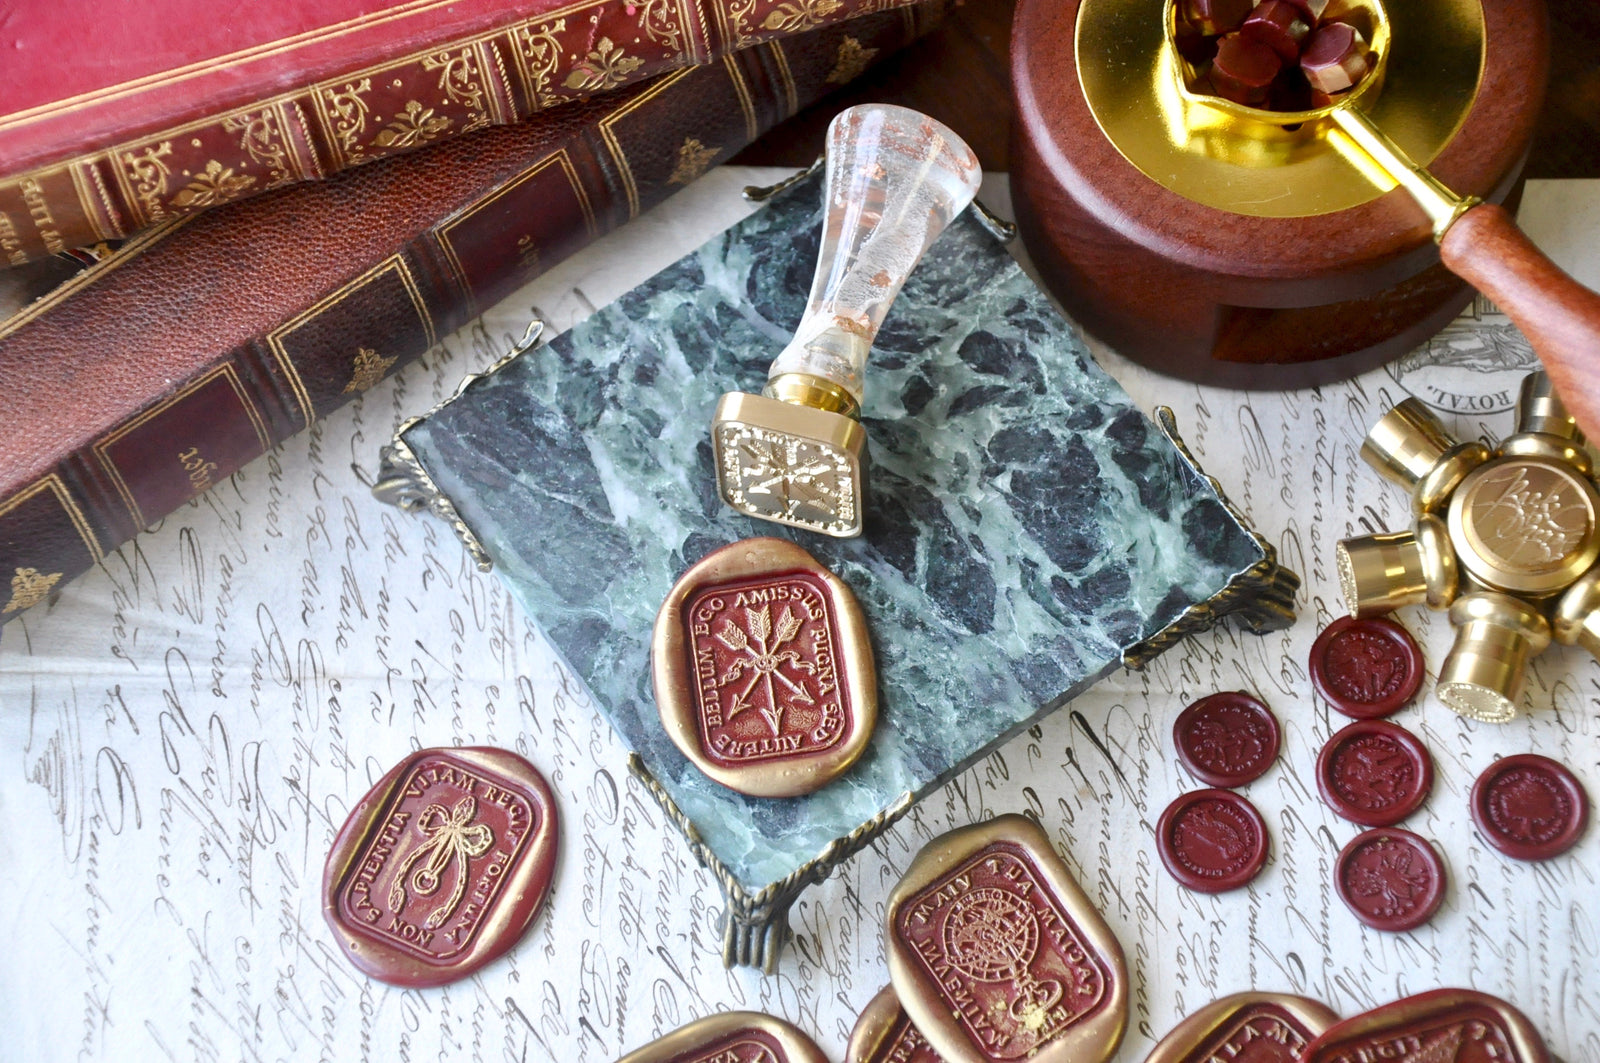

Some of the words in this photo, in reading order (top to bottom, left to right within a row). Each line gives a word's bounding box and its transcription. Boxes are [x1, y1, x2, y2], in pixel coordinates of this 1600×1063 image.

[695, 597, 725, 636] EGO
[734, 586, 824, 622] AMISSUS
[810, 629, 835, 696] PUGNA
[700, 646, 724, 728] BELLUM
[814, 703, 839, 743] SED
[355, 811, 412, 922] SAPIENTIA
[388, 916, 434, 947] NON
